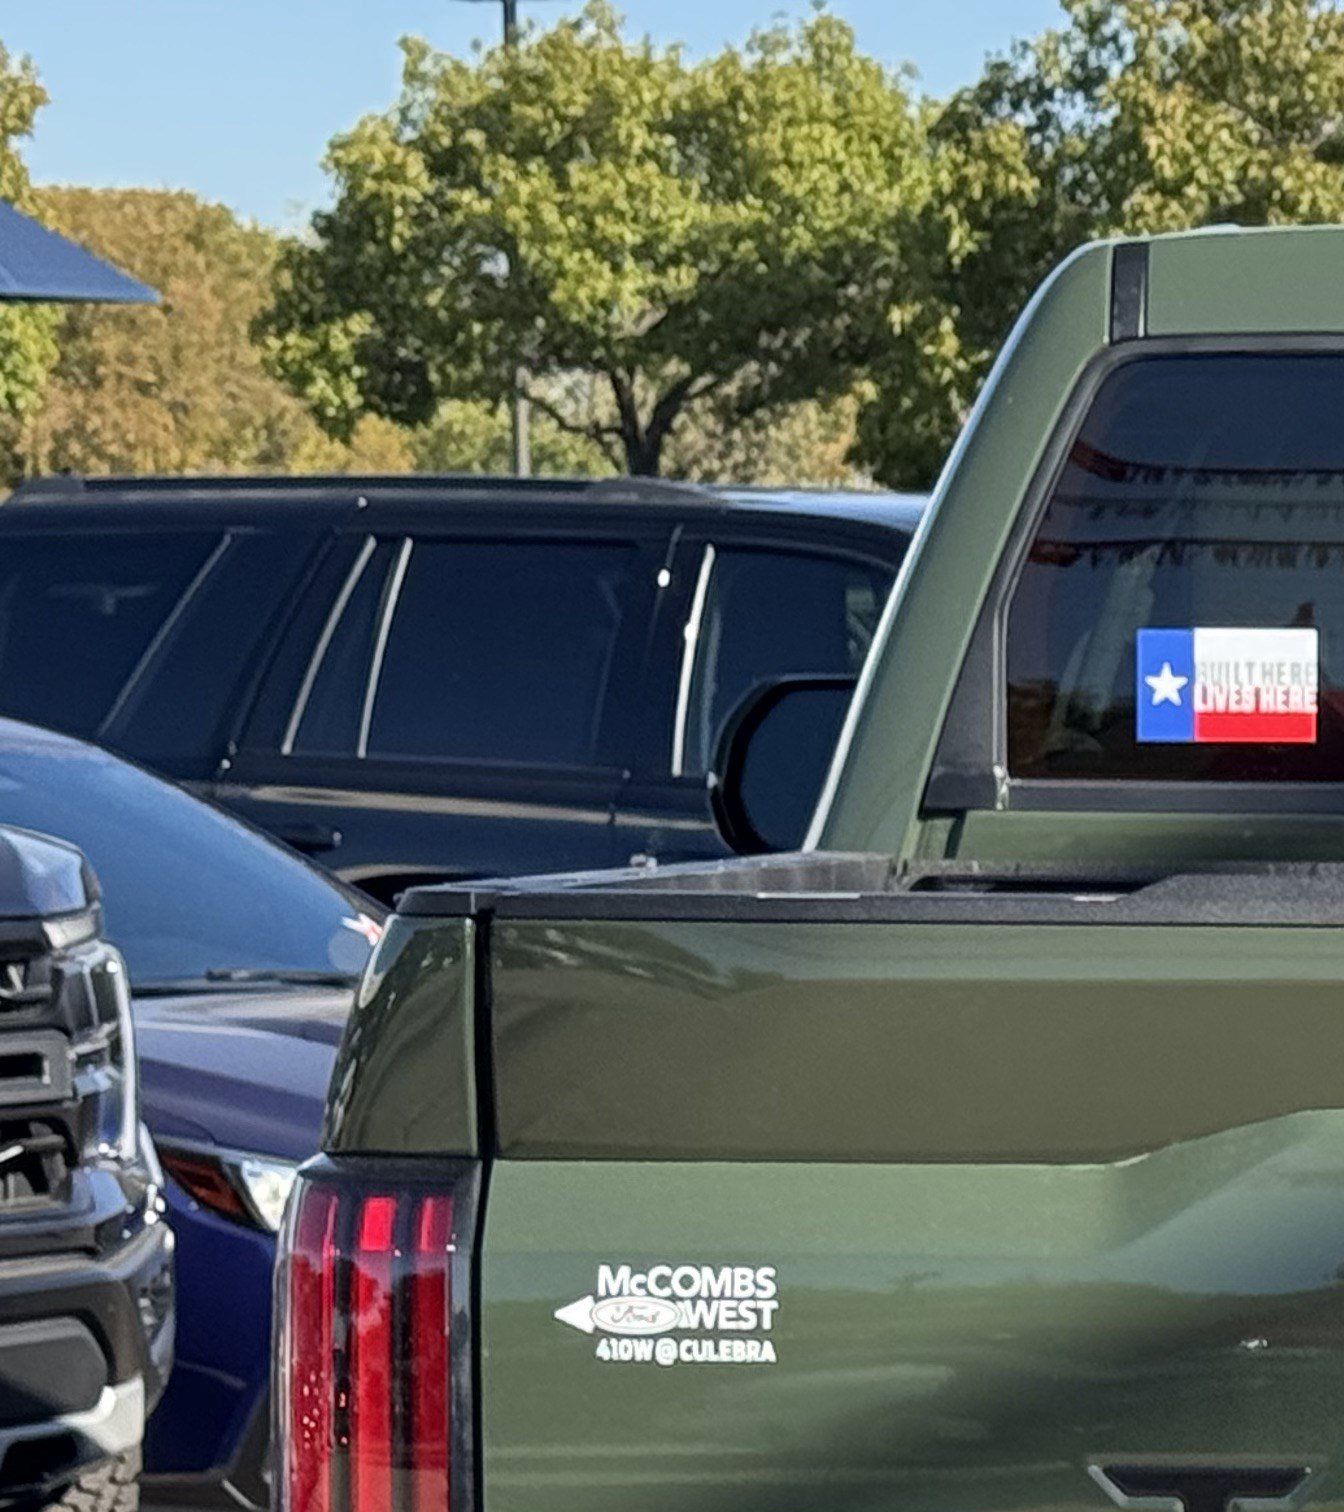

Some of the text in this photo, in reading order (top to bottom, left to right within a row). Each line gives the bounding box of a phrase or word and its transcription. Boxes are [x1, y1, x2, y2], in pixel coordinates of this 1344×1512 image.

[1198, 661, 1317, 686] BUILT HERE
[1195, 683, 1318, 713] LIVES HERE
[598, 1265, 778, 1299] McCOMBS
[682, 1300, 779, 1330] WEST
